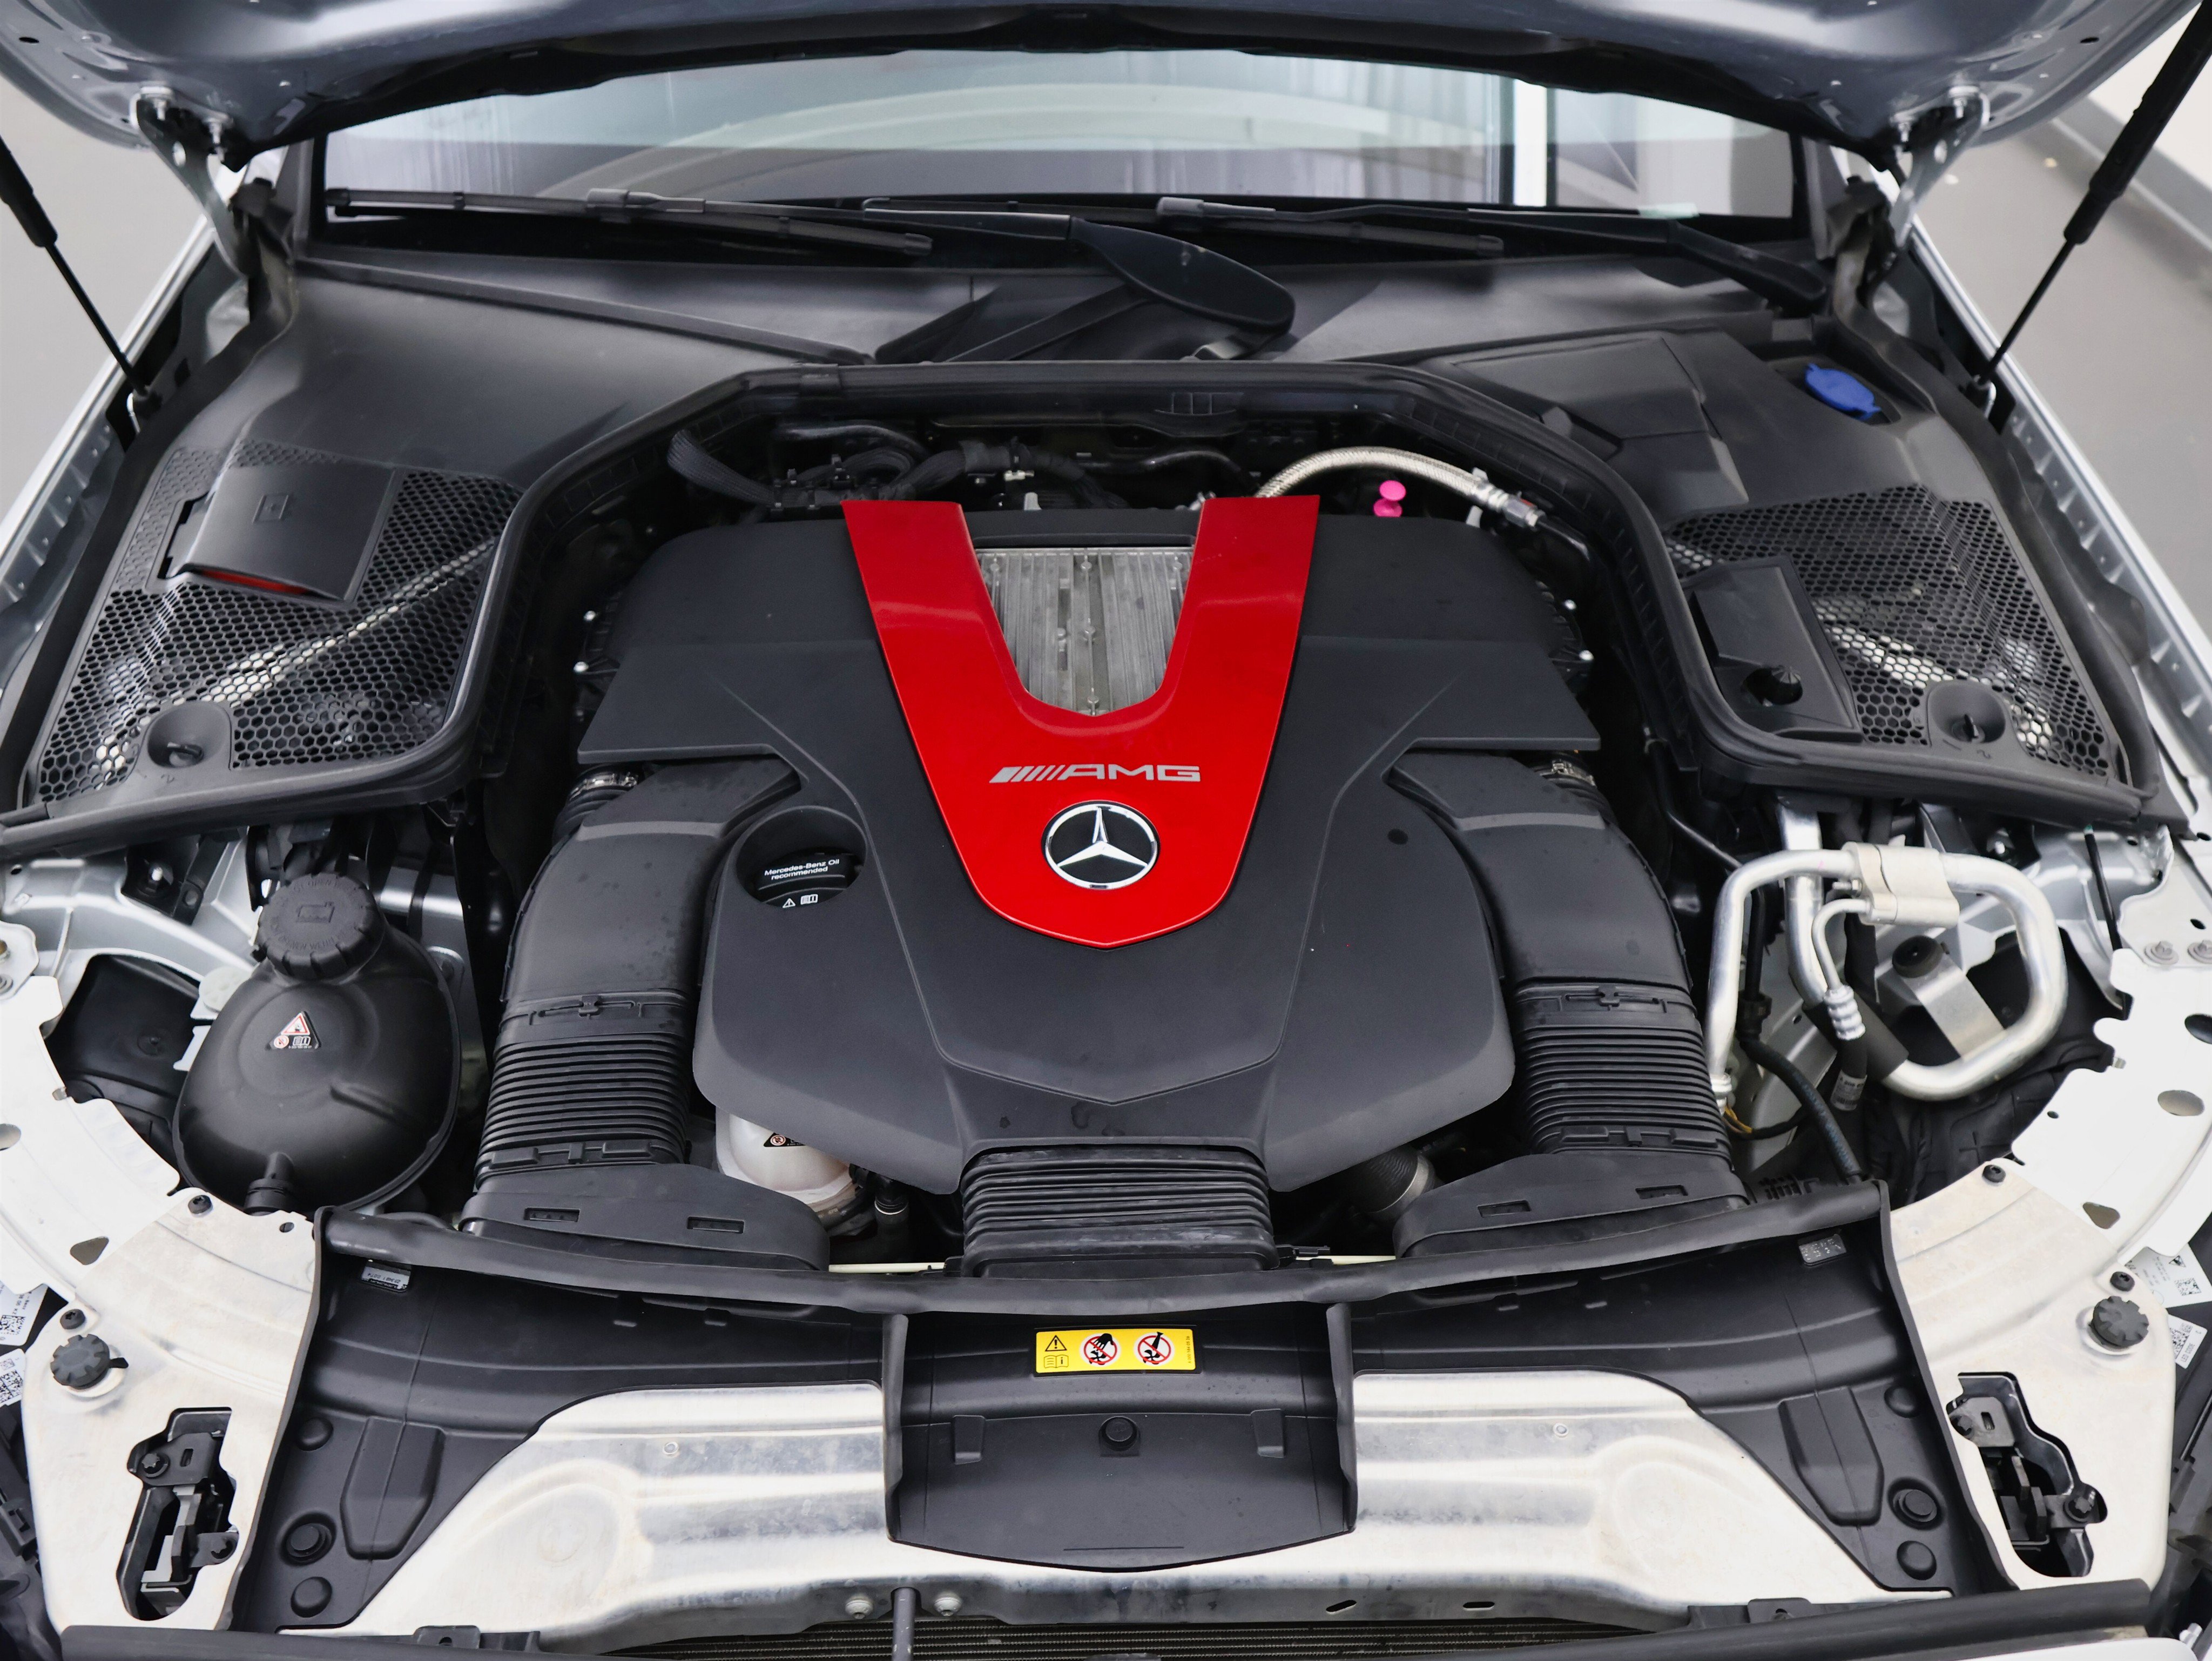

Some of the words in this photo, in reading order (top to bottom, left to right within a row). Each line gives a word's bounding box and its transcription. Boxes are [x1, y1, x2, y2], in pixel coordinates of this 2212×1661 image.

[1057, 764, 1201, 782] AMG
[764, 861, 826, 876] Mercedes-Benz
[771, 866, 828, 880] recommended
